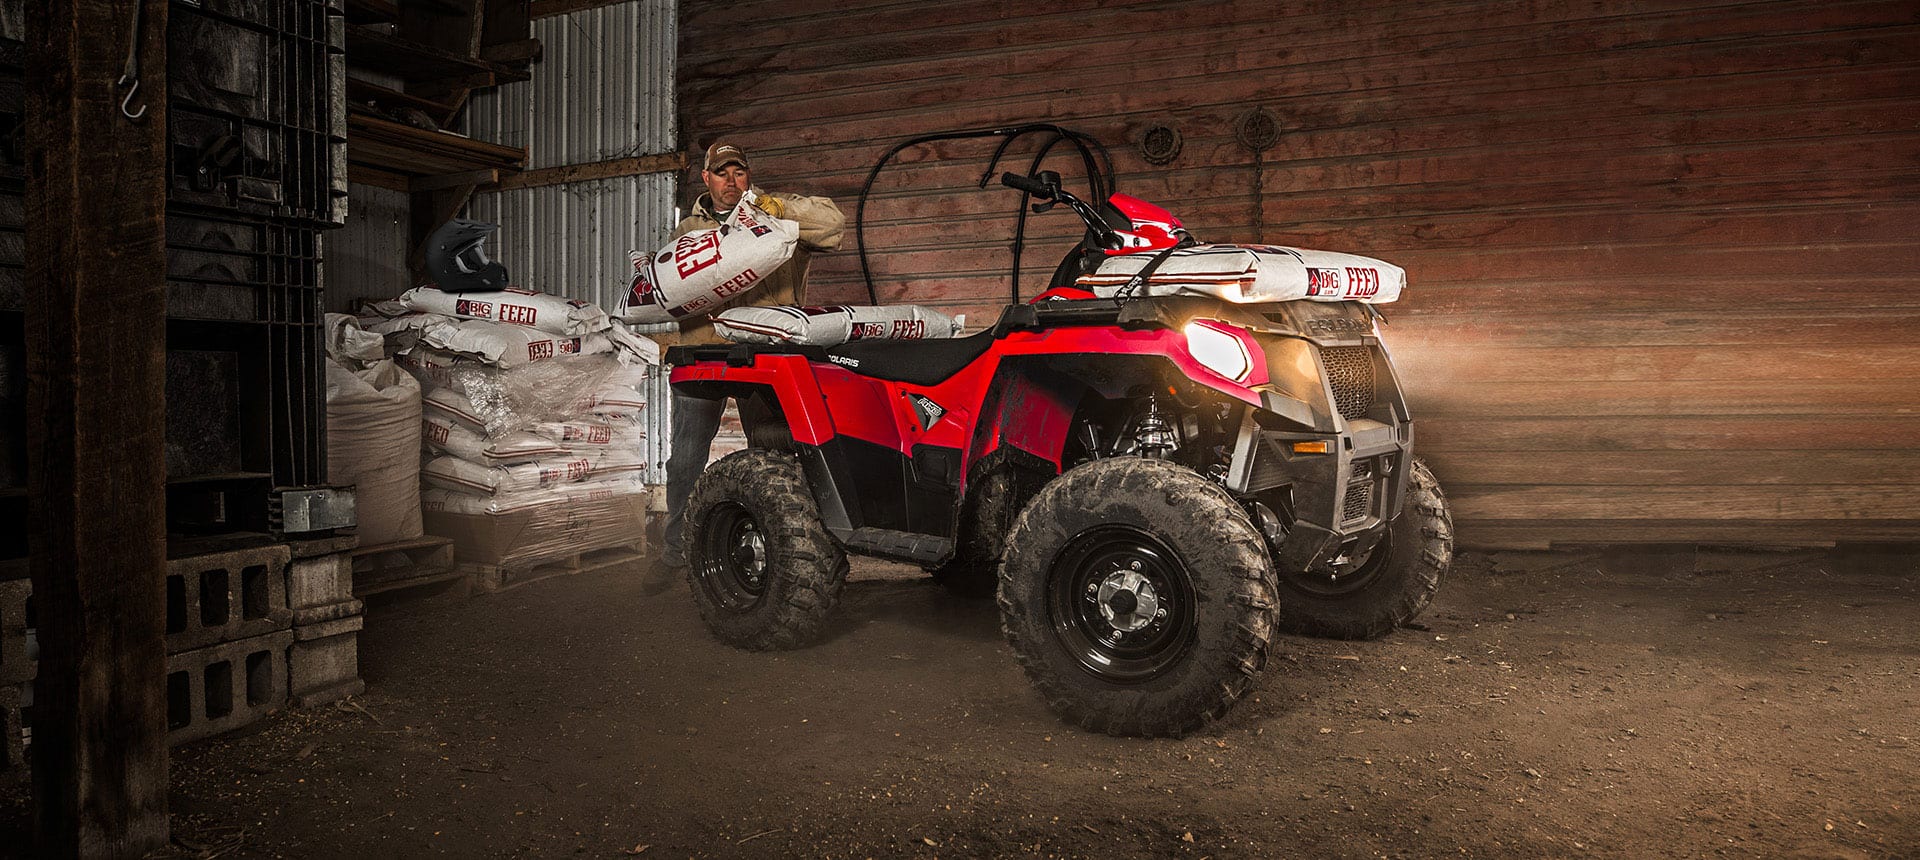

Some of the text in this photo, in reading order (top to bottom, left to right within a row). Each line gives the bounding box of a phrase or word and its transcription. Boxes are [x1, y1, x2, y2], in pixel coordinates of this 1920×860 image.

[683, 268, 759, 312] BIG FEED
[1321, 267, 1380, 296] BIG FEED
[470, 302, 537, 324] BIG FEED
[864, 320, 925, 340] BIG FEED
[422, 421, 449, 444] EED
[587, 426, 610, 441] FEED
